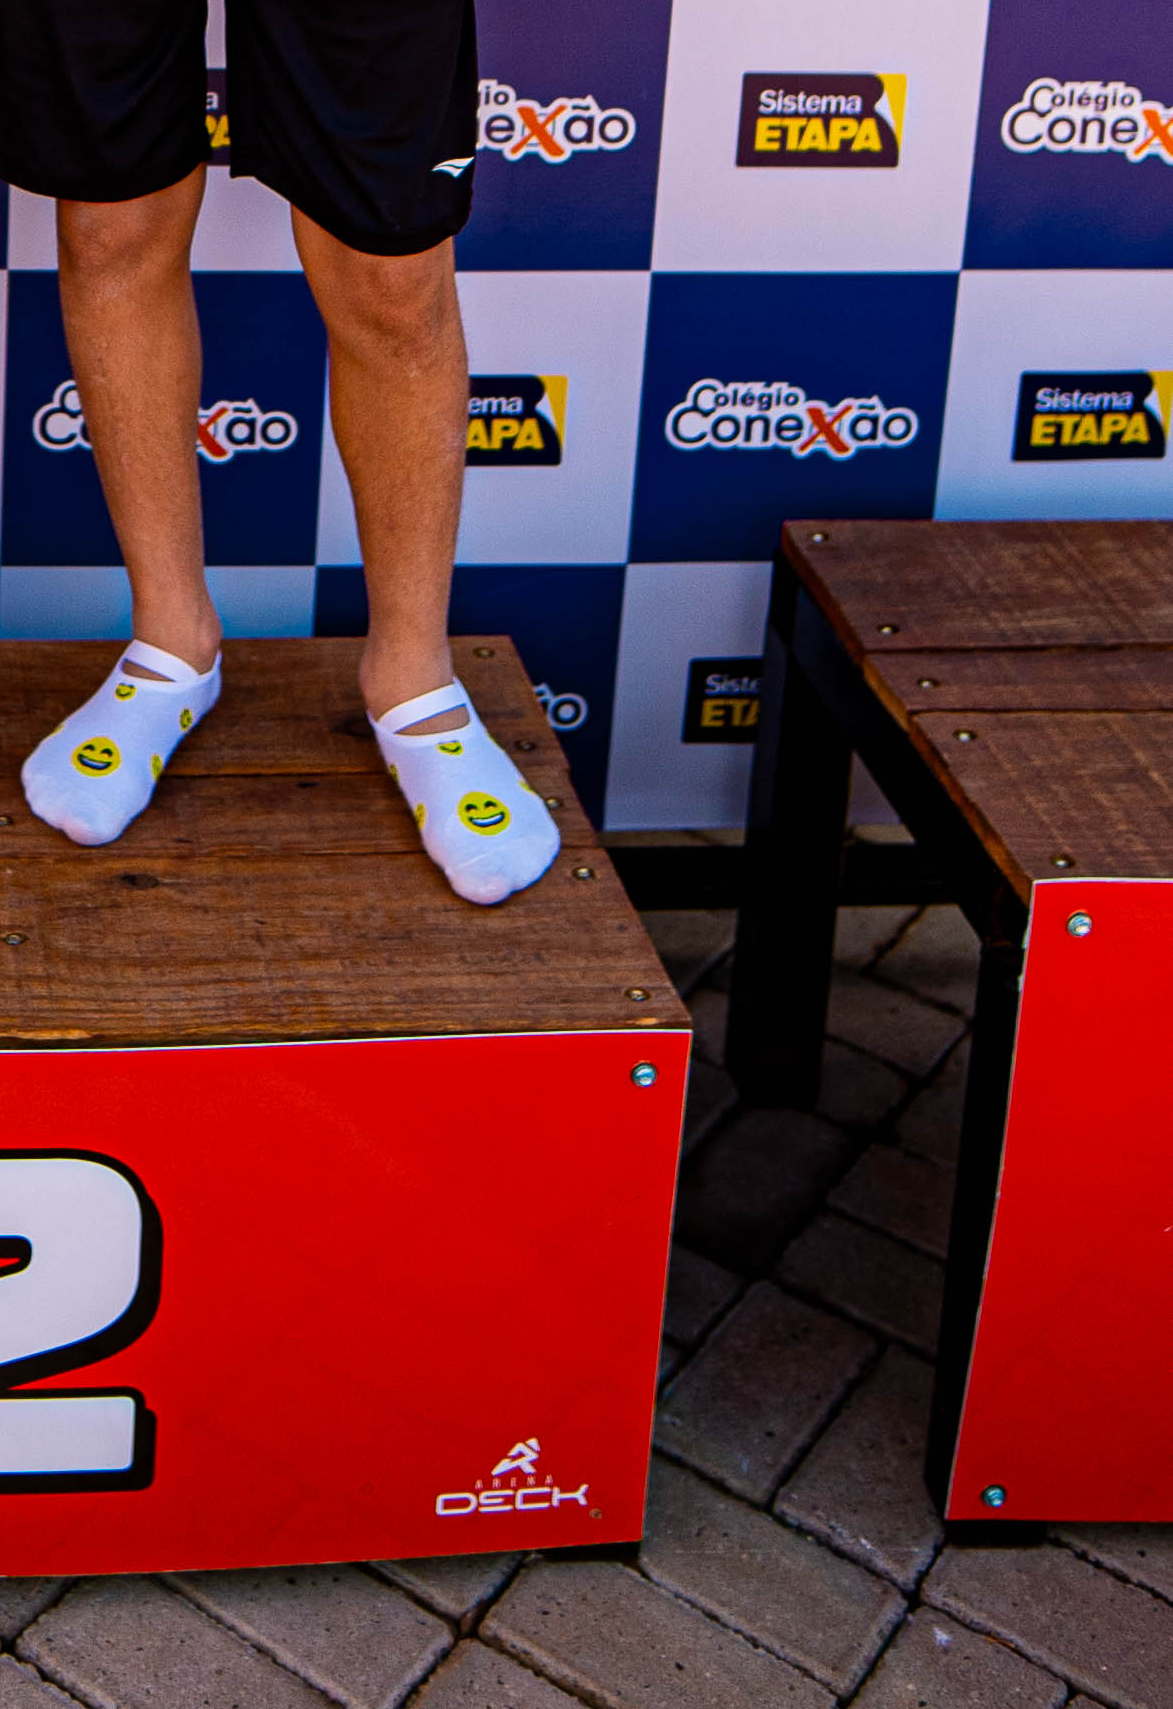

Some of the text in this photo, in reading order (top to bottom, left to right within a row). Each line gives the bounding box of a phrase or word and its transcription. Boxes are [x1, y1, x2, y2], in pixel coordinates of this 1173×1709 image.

[759, 90, 862, 115] Sistema
[1031, 86, 1134, 115] Colégio
[485, 104, 629, 156] eXão
[754, 117, 882, 153] ETAPA
[1009, 108, 1173, 157] ConeX
[693, 385, 800, 412] Colégio
[1035, 387, 1132, 411] Sistema
[464, 418, 543, 450] APA
[1030, 412, 1150, 446] ETAPA
[435, 1484, 589, 1516] DECK
